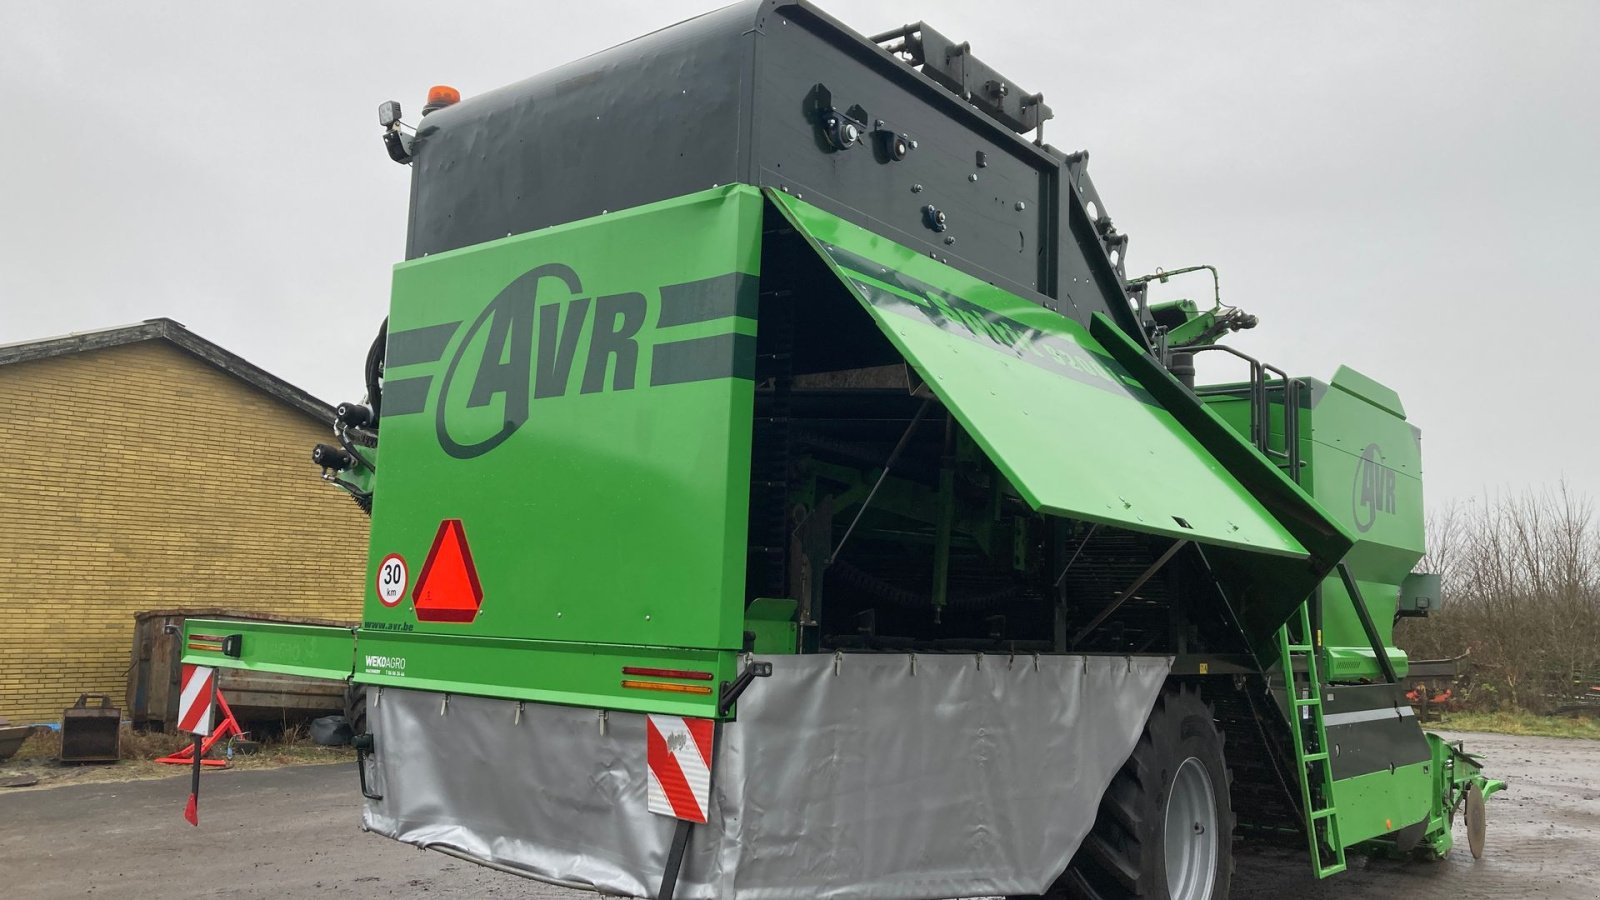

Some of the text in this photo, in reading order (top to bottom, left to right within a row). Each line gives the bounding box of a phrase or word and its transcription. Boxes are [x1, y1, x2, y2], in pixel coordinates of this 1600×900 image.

[436, 262, 647, 459] AVR
[1353, 443, 1396, 533] AVR
[384, 564, 401, 584] 30
[387, 588, 397, 597] km
[364, 621, 414, 630] www.avr.be
[365, 655, 406, 669] WEKOAGRO
